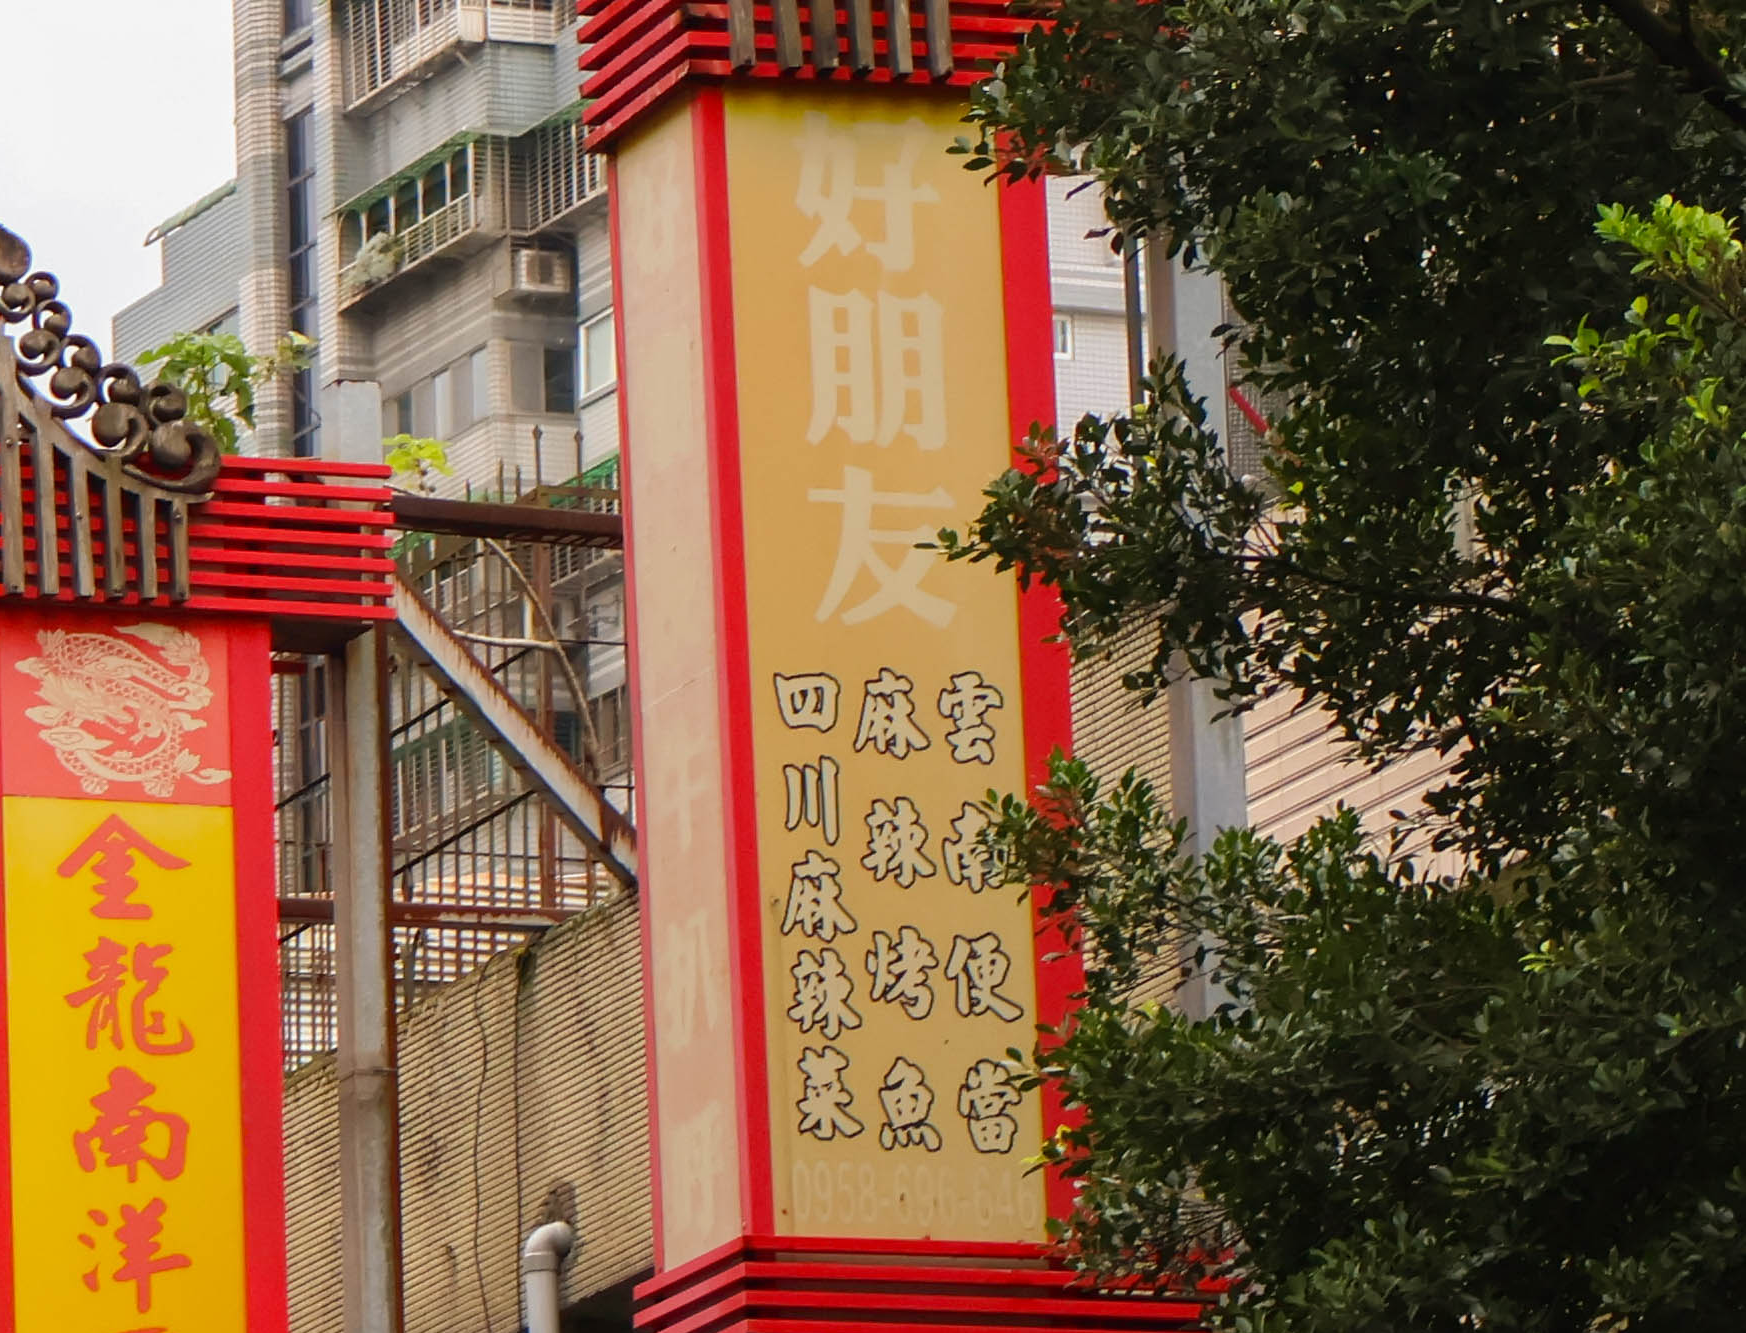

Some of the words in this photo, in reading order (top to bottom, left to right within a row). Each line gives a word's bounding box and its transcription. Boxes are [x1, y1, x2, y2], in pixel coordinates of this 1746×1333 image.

[773, 672, 865, 1142] 四川麻辣菜
[853, 667, 942, 1154] 麻辣烤魚
